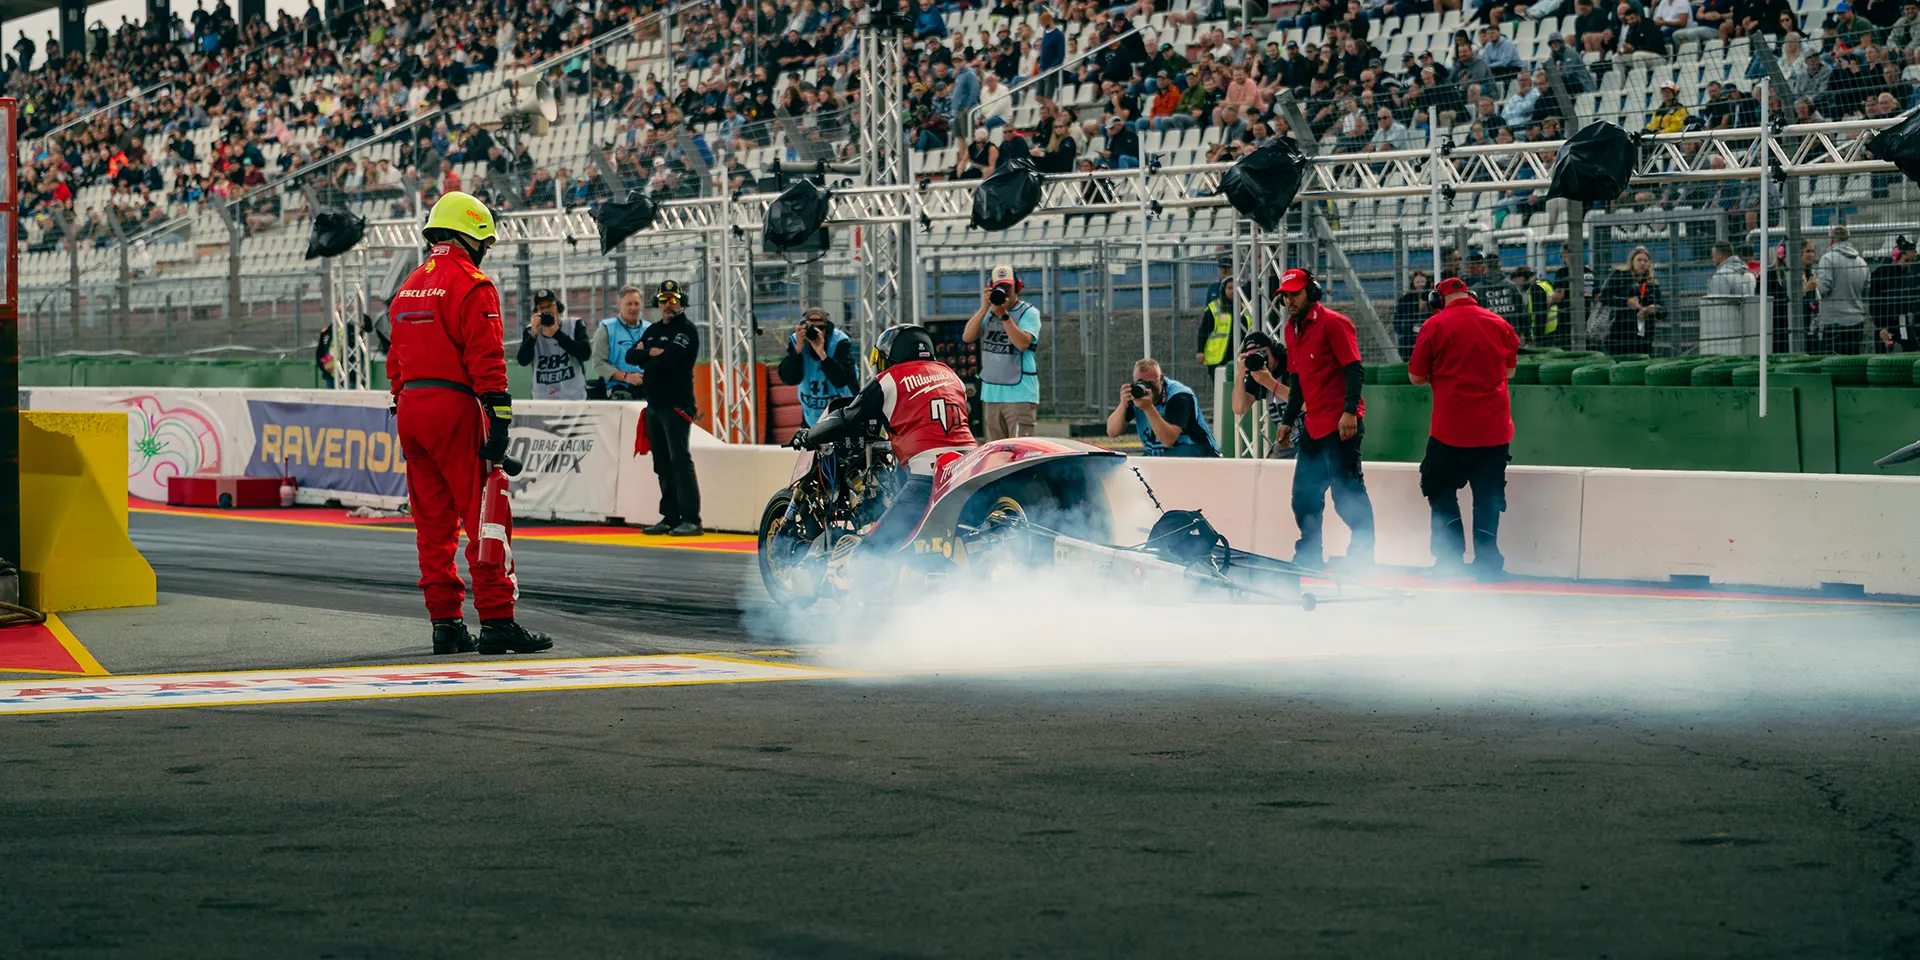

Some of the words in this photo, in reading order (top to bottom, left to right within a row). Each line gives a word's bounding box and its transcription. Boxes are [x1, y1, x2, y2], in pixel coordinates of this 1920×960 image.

[427, 288, 446, 297] CAR
[1485, 289, 1511, 298] OFF
[1487, 297, 1512, 306] THE
[537, 352, 570, 370] 284
[260, 424, 408, 474] RAVENOL
[531, 439, 560, 452] DRAG
[558, 439, 594, 452] RACING
